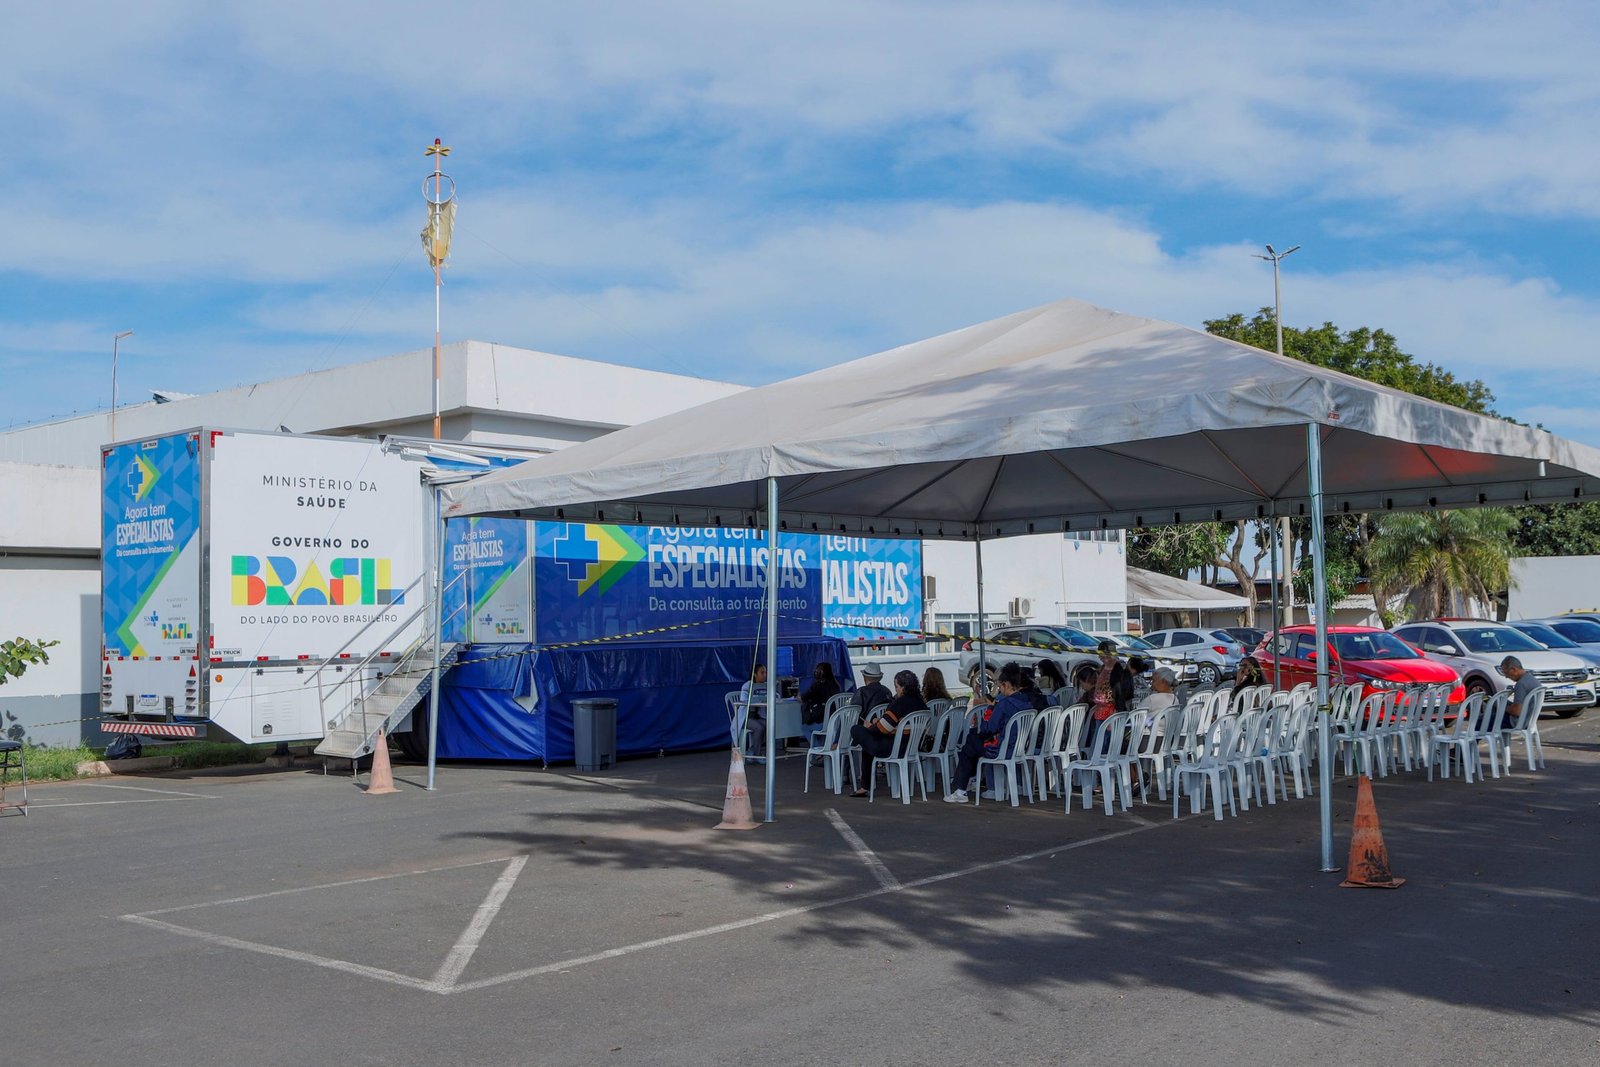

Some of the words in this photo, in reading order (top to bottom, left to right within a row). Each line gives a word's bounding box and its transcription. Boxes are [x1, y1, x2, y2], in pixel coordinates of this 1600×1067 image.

[262, 474, 352, 491] MINISTÉRIO
[359, 480, 377, 492] DA
[297, 494, 346, 509] SAÚDE
[125, 506, 148, 522] Agora
[150, 504, 166, 516] tem
[116, 518, 174, 546] ESPECIALISTAS
[479, 529, 495, 539] tem
[272, 536, 343, 549] GOVERNO
[351, 538, 370, 549] DO
[827, 535, 866, 552] tem
[231, 555, 405, 606] BRASIL
[649, 596, 666, 611] Da
[670, 596, 724, 611] consulta
[727, 599, 741, 610] ao
[240, 616, 256, 624] DO
[260, 616, 289, 624] LADO
[292, 616, 308, 624] DO
[312, 615, 340, 624] POVO
[343, 614, 398, 623] BRASILEIRO
[830, 616, 845, 628] ao
[847, 613, 909, 628] tratamento
